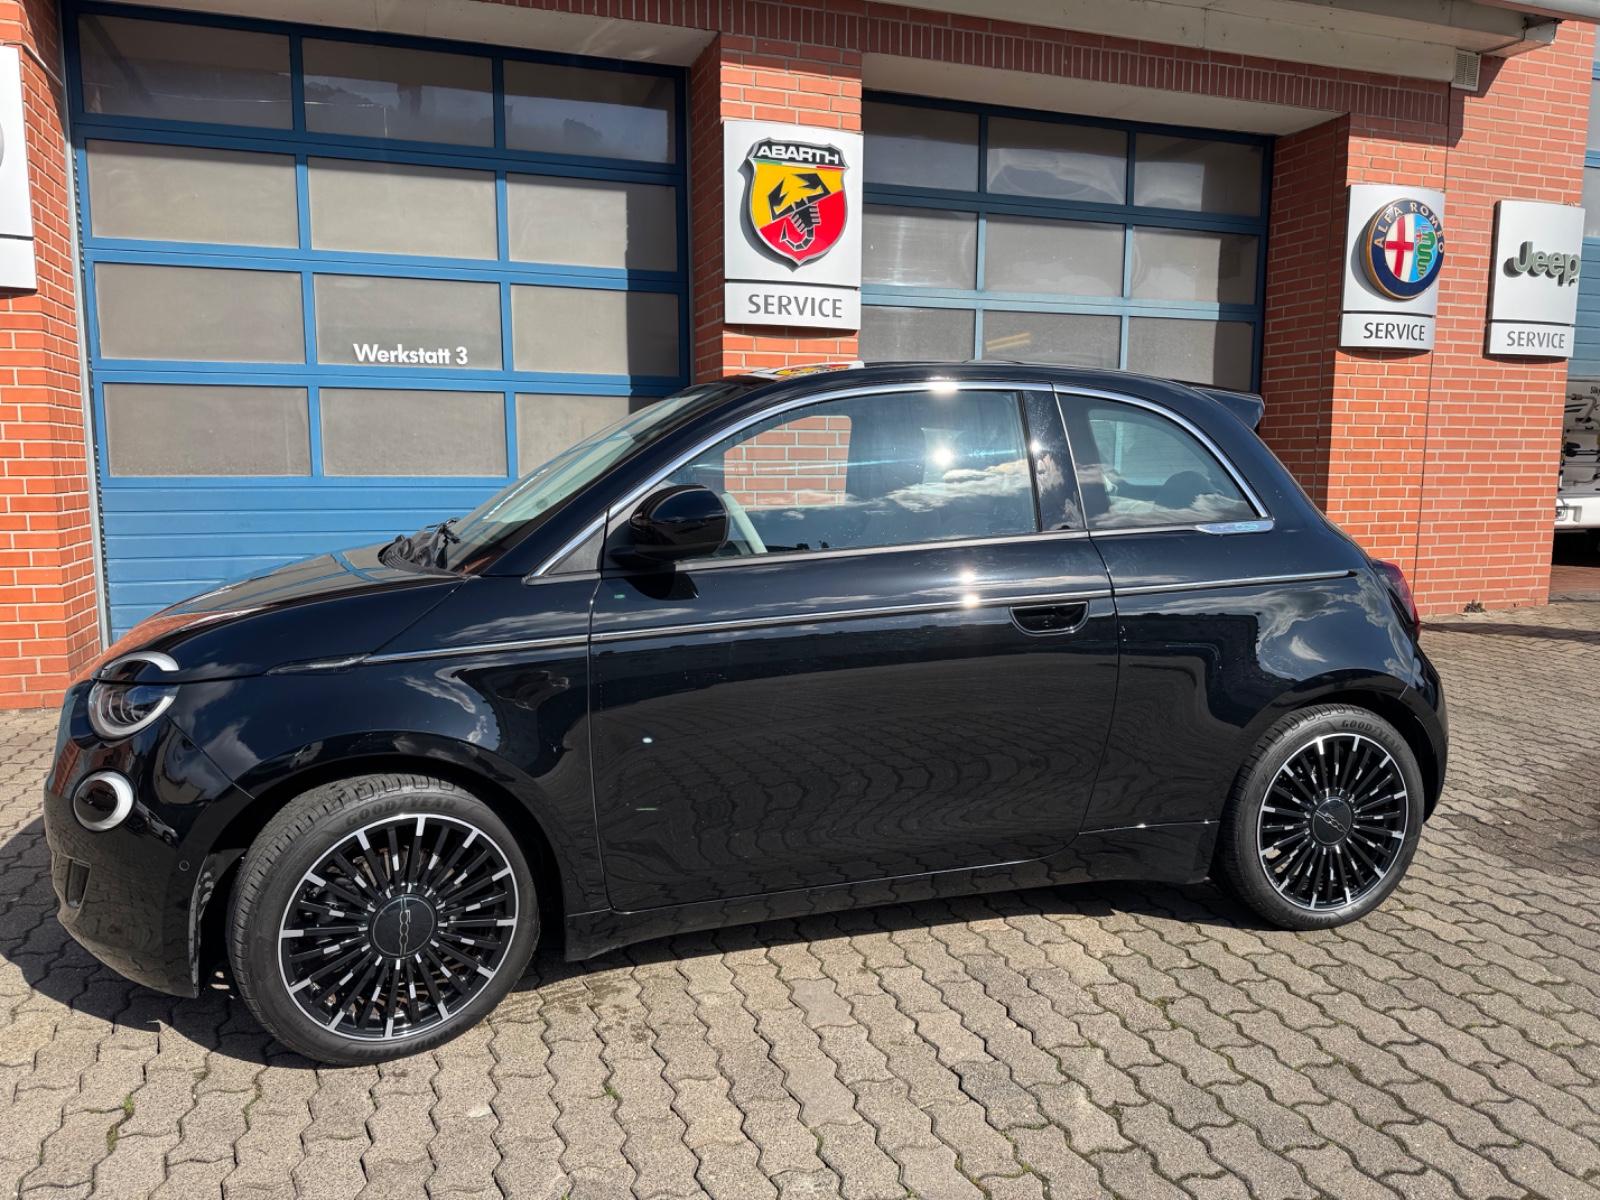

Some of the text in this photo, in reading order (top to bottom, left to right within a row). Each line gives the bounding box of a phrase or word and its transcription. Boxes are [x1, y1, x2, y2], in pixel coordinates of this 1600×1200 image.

[757, 145, 839, 165] ABARTH
[1373, 201, 1445, 254] ALFA ROMEO
[1513, 241, 1581, 283] Jeep
[748, 294, 842, 318] SERVICE
[1363, 322, 1426, 341] SERVICE
[1506, 331, 1565, 349] SERVICE
[353, 343, 468, 365] Werkstatt 3
